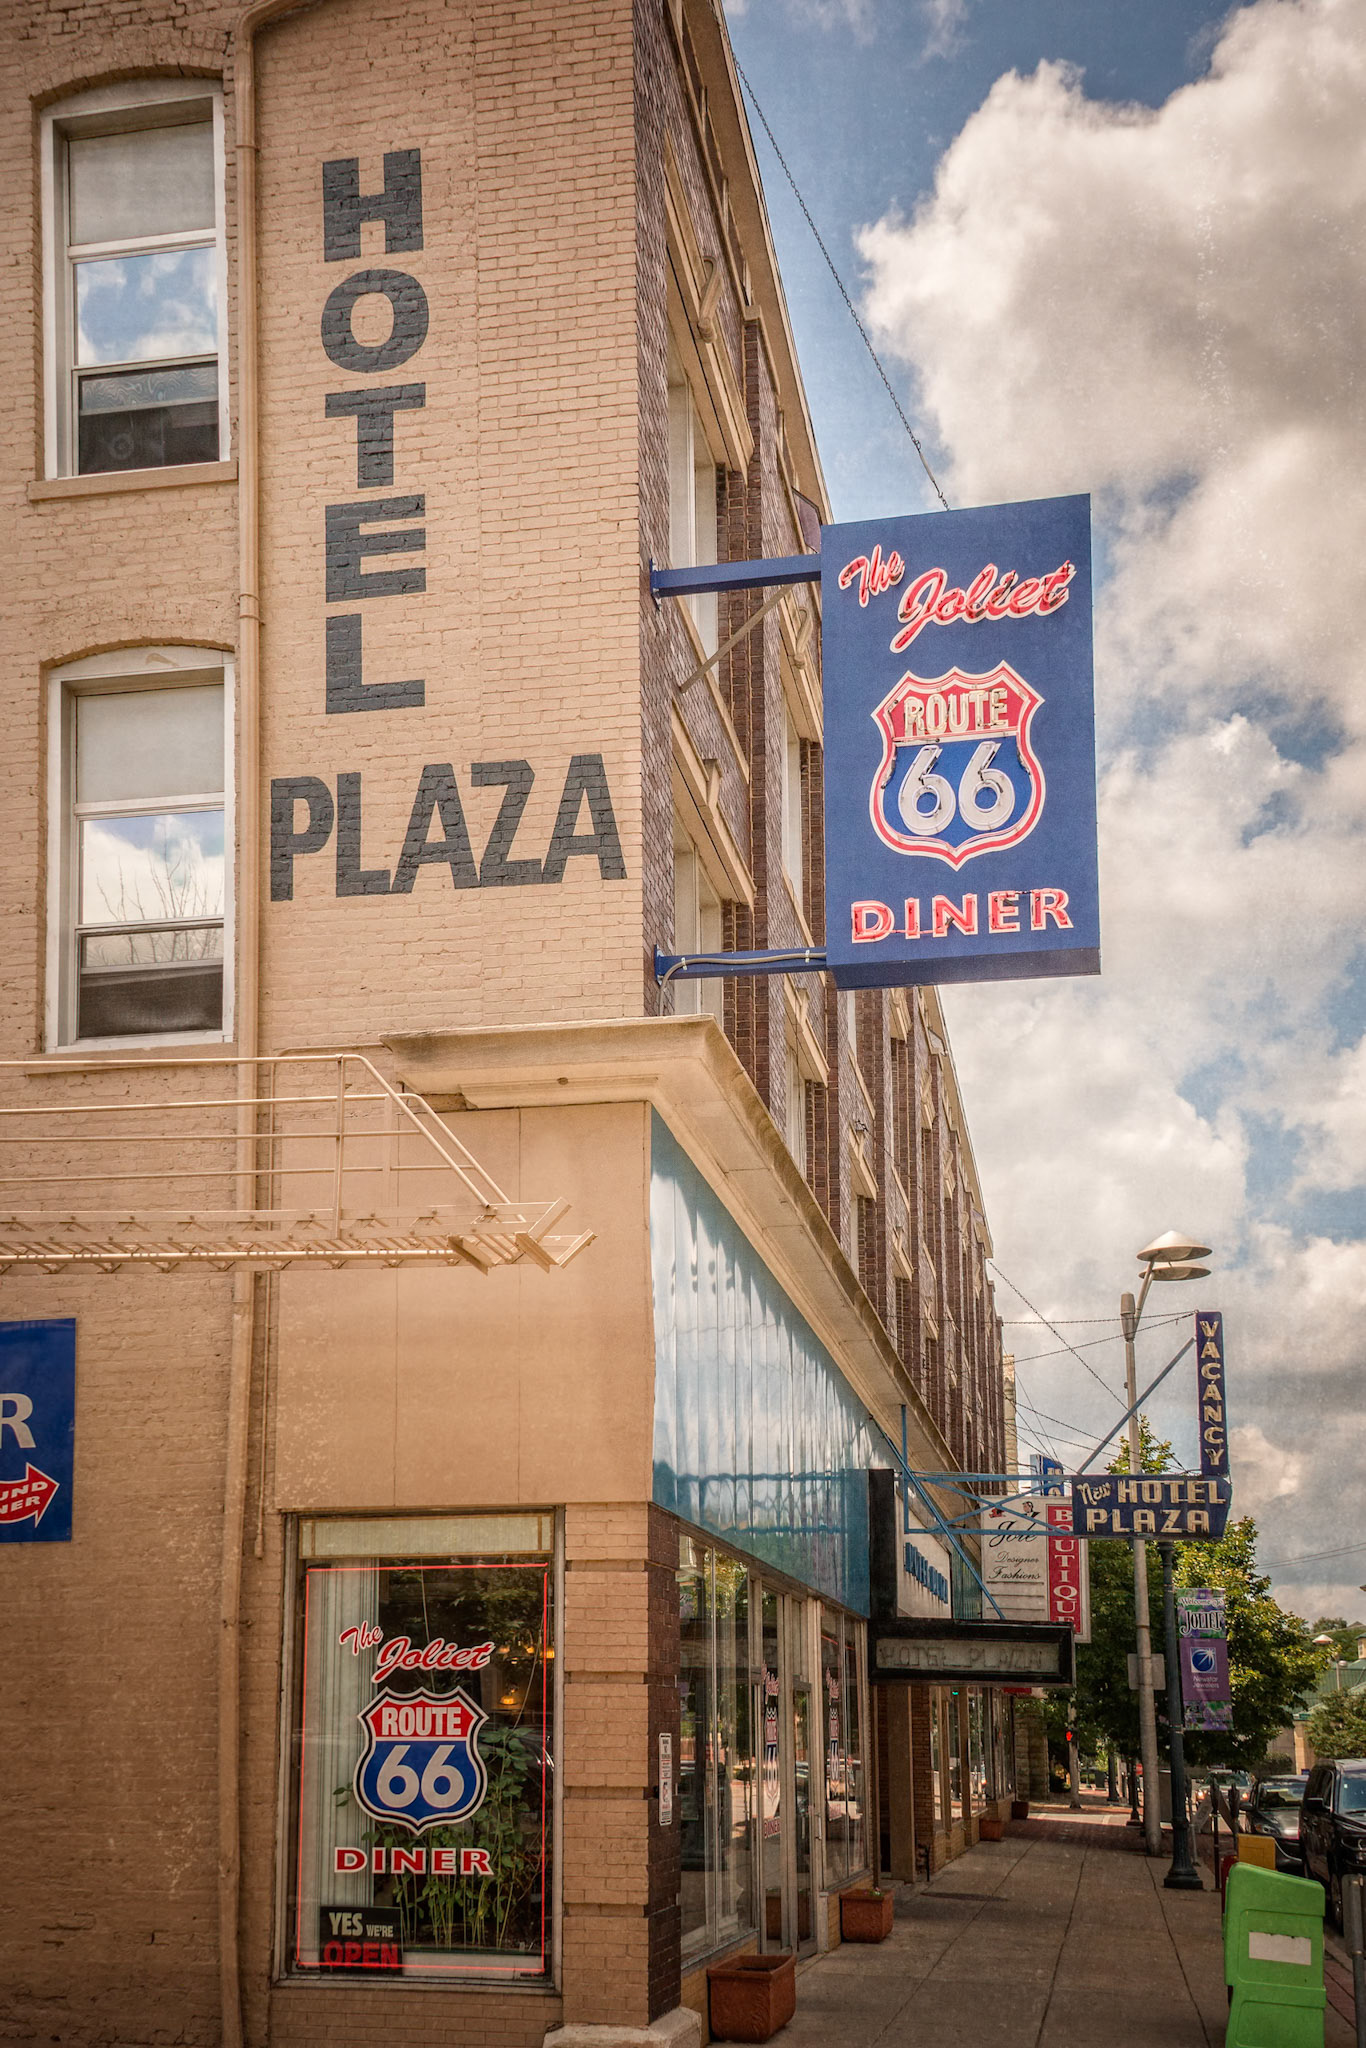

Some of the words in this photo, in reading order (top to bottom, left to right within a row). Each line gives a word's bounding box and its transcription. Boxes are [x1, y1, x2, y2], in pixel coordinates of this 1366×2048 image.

[322, 148, 429, 714] HOTEL
[839, 544, 905, 608] The
[890, 560, 1075, 653] Joliet
[904, 688, 1008, 735] ROUTE
[898, 741, 1016, 836] 66
[270, 753, 628, 901] PLAZA
[851, 887, 1074, 943] DINER
[1200, 1320, 1224, 1466] VACANCY
[1076, 1482, 1112, 1506] New
[1117, 1479, 1226, 1504] HOTEL
[1086, 1508, 1210, 1533] PLAZA
[989, 1566, 1041, 1579] Fashions
[994, 1551, 1040, 1567] Designer
[339, 1620, 383, 1655] The
[371, 1635, 496, 1684] Joliet
[381, 1706, 462, 1736] ROUTE
[376, 1744, 465, 1809] 66
[334, 1846, 494, 1876] DINER
[329, 1912, 363, 1936] YES
[366, 1924, 394, 1938] WE'RE
[323, 1940, 399, 1969] OPEN
